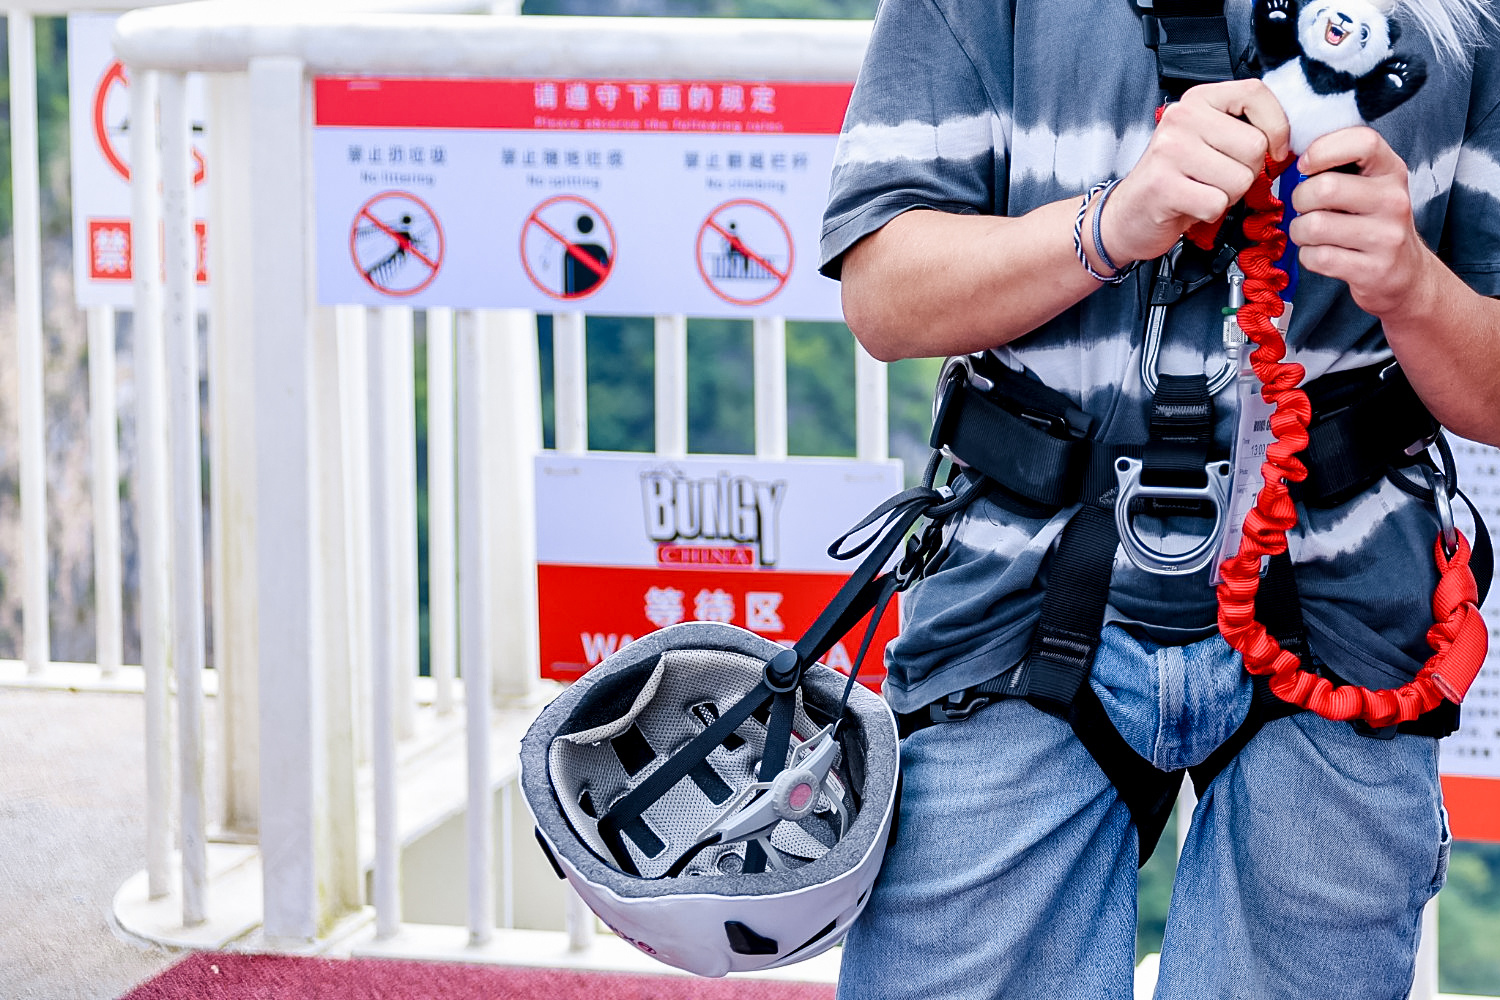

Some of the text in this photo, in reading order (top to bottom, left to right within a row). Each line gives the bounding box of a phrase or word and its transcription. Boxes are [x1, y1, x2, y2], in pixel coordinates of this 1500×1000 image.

[533, 82, 777, 113] 请遵守下面的规定
[659, 547, 750, 565] CHINA
[644, 586, 785, 631] 等待区
